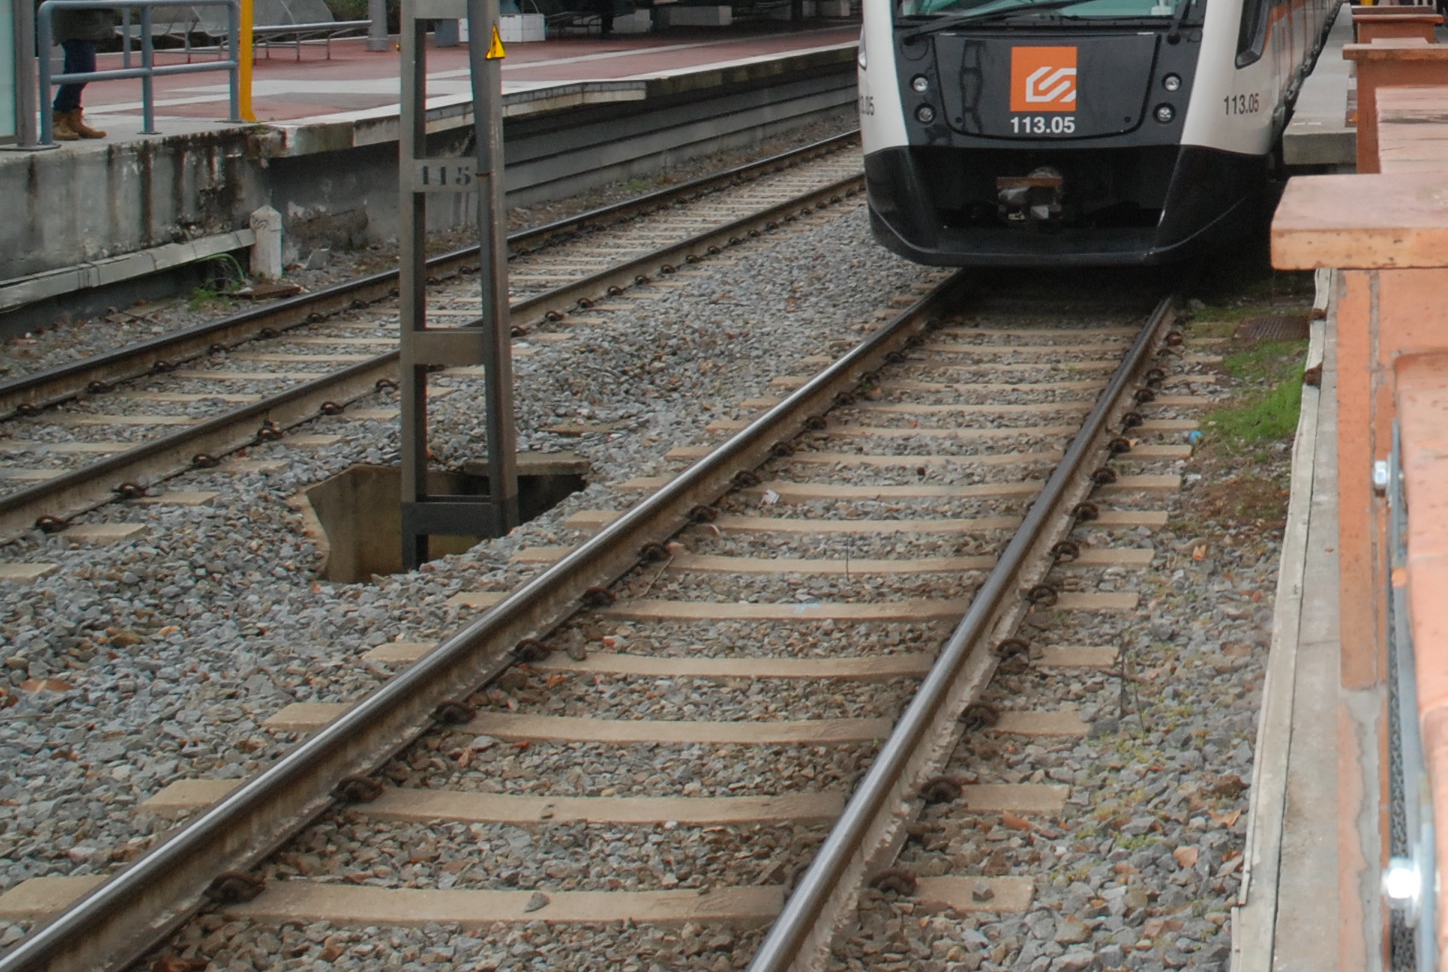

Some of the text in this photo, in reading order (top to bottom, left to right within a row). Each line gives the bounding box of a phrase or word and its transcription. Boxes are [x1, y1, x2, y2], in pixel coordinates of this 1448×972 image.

[1223, 92, 1260, 115] 113.05
[1010, 116, 1076, 134] 113.05
[422, 165, 472, 186] 115
